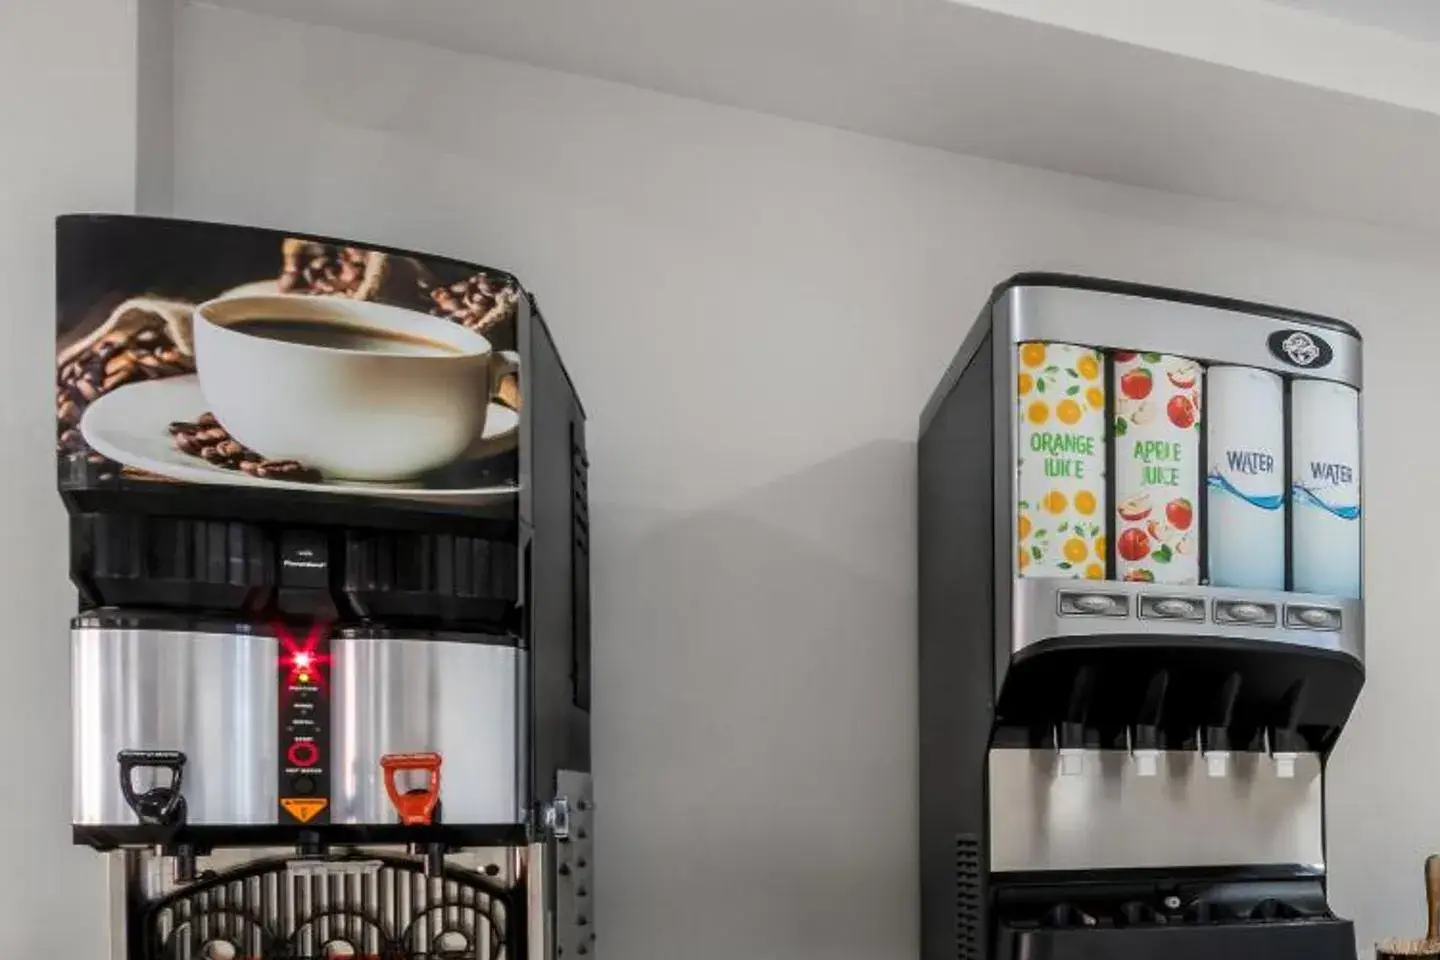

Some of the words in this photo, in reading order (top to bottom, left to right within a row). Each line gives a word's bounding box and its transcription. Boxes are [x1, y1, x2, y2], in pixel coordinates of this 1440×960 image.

[1030, 432, 1094, 456] ORANGE
[1226, 450, 1274, 475] WATER
[1310, 461, 1353, 485] WATER
